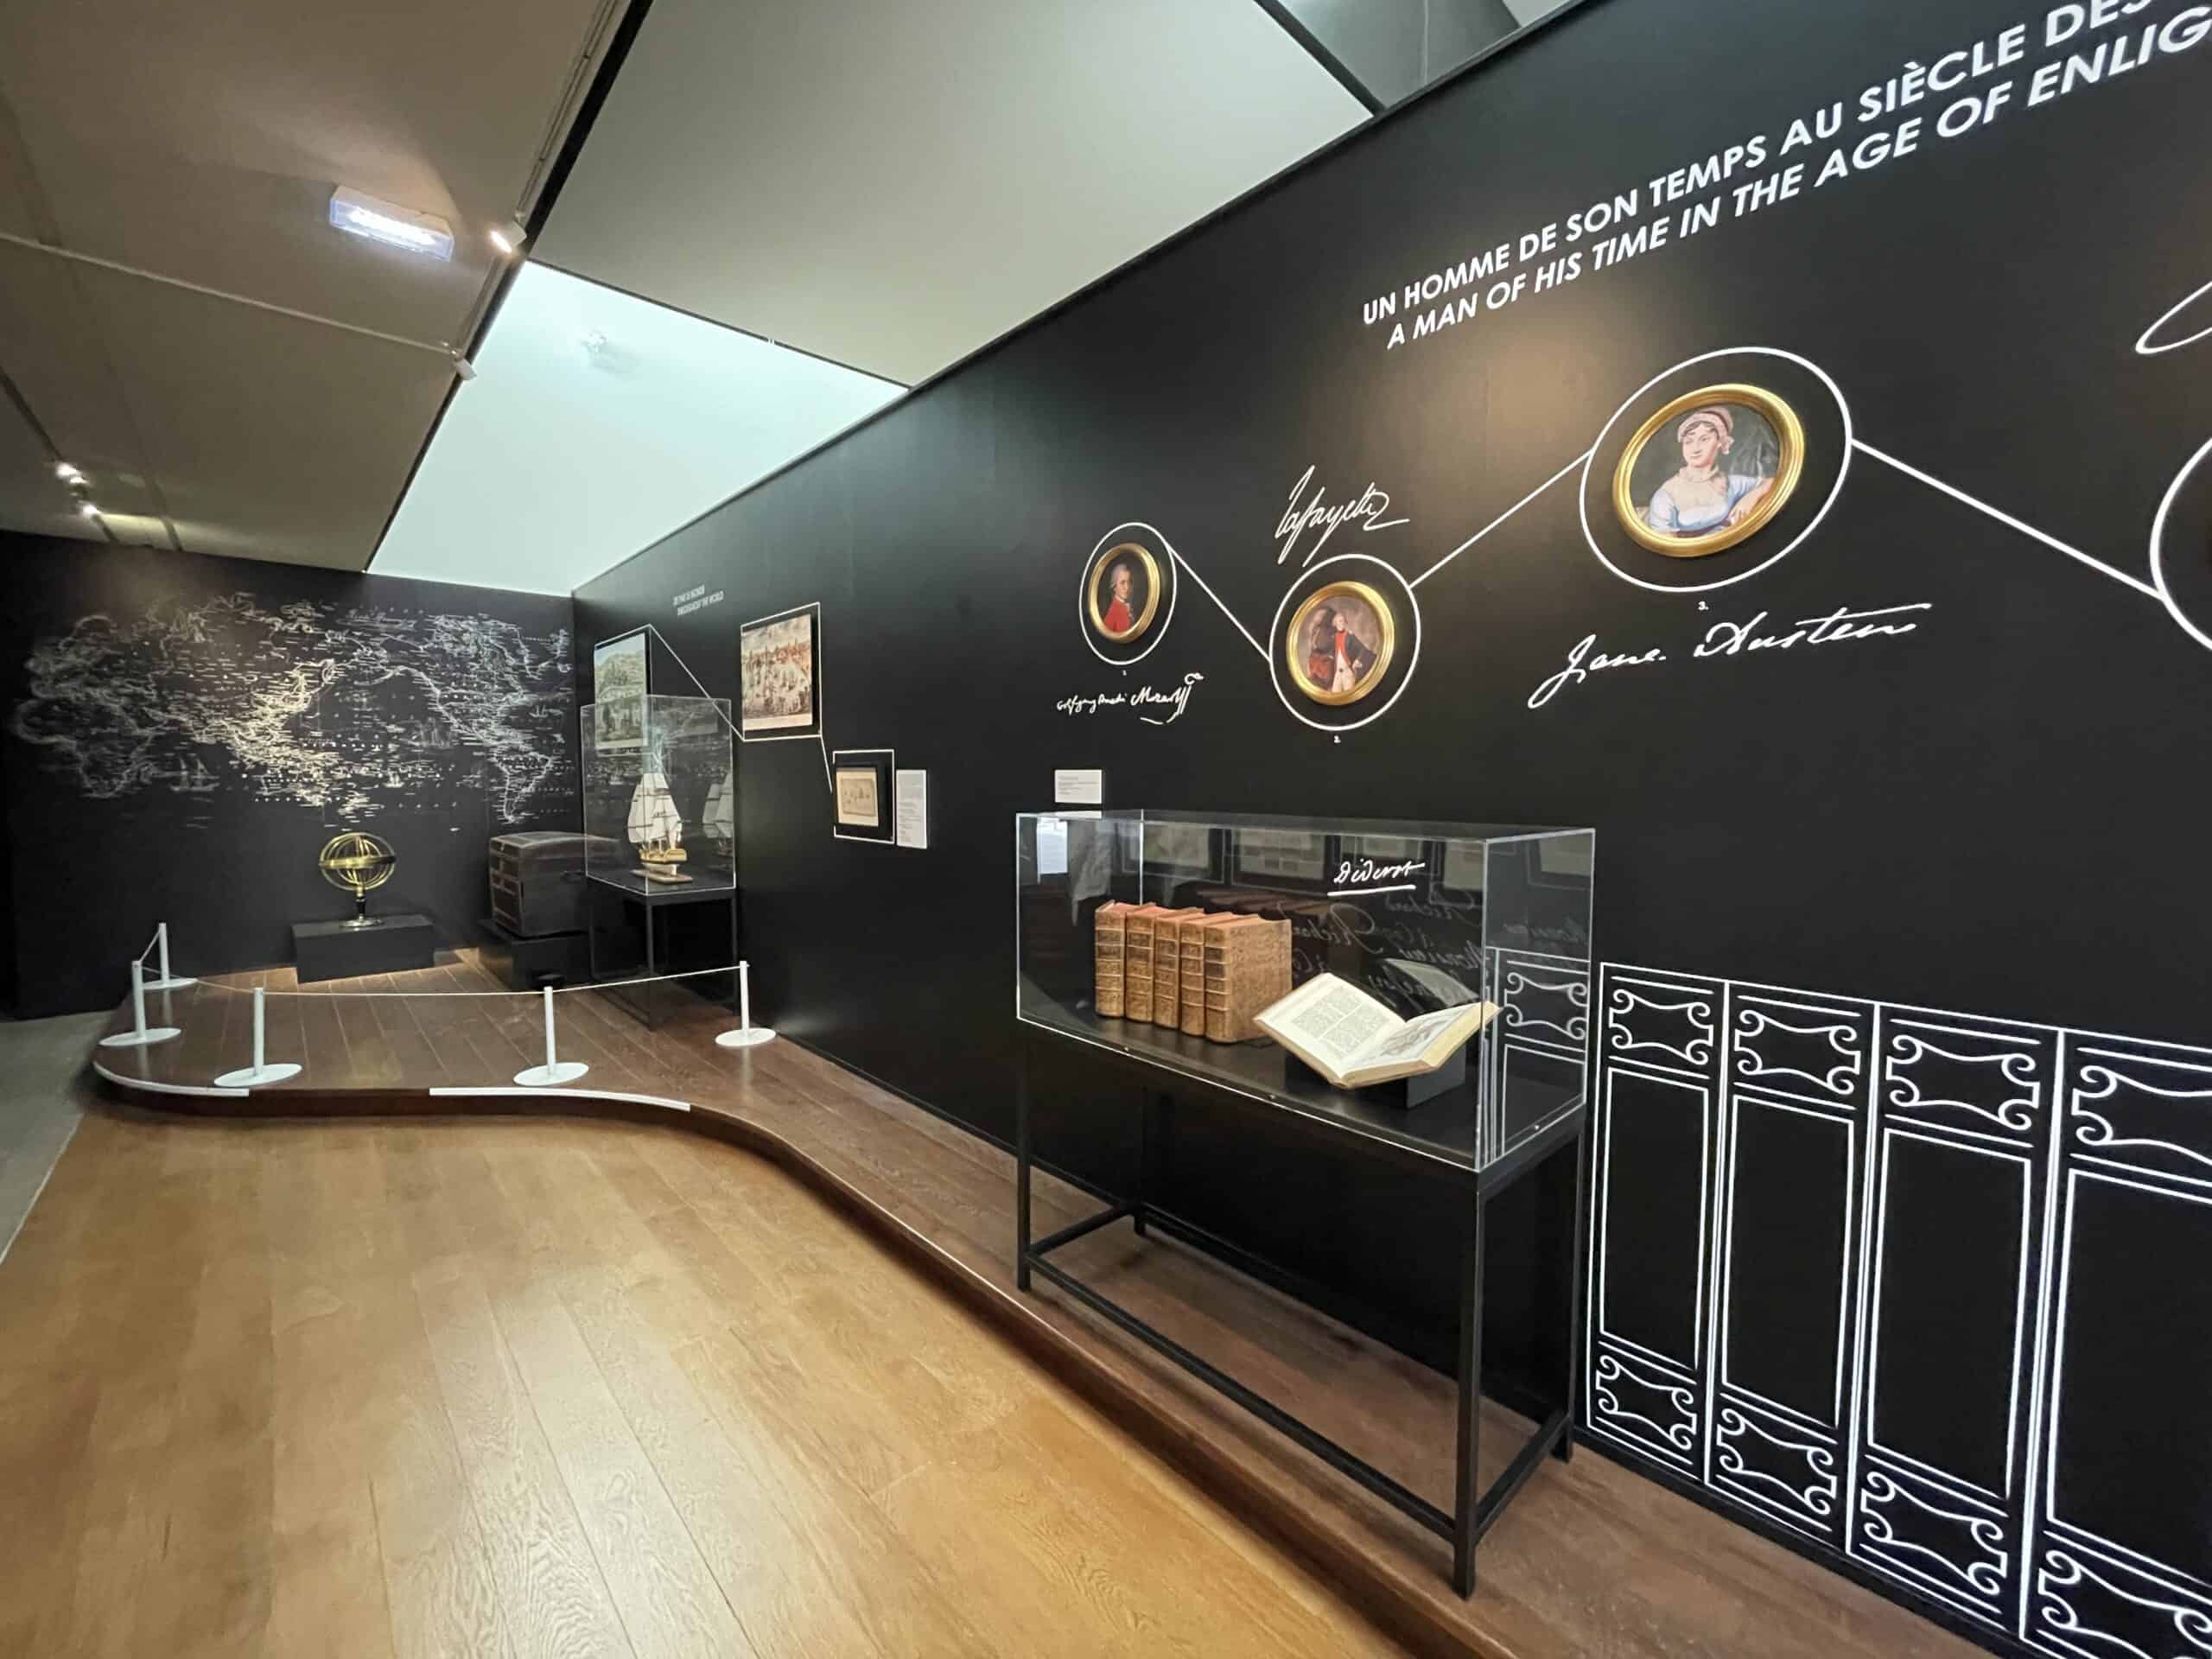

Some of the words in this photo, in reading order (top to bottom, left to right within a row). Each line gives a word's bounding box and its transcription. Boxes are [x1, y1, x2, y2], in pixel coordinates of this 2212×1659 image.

[1363, 291, 1396, 325] UN
[1404, 244, 1511, 309] HOMME
[1519, 223, 1557, 263] DE
[1565, 188, 1638, 242] SON
[1649, 135, 1767, 207] TEMPS
[1779, 101, 1842, 156] AU
[1857, 24, 2025, 123] SIÈCLE
[1387, 322, 1406, 350] A
[1412, 292, 1478, 340] MAN
[1485, 272, 1527, 310] OF
[1534, 251, 1583, 294] HIS
[1592, 216, 1670, 271] TIME
[1679, 196, 1721, 238] IN
[1732, 162, 1805, 217] THE
[1814, 118, 1923, 188] AGE
[1936, 80, 2013, 137] OF
